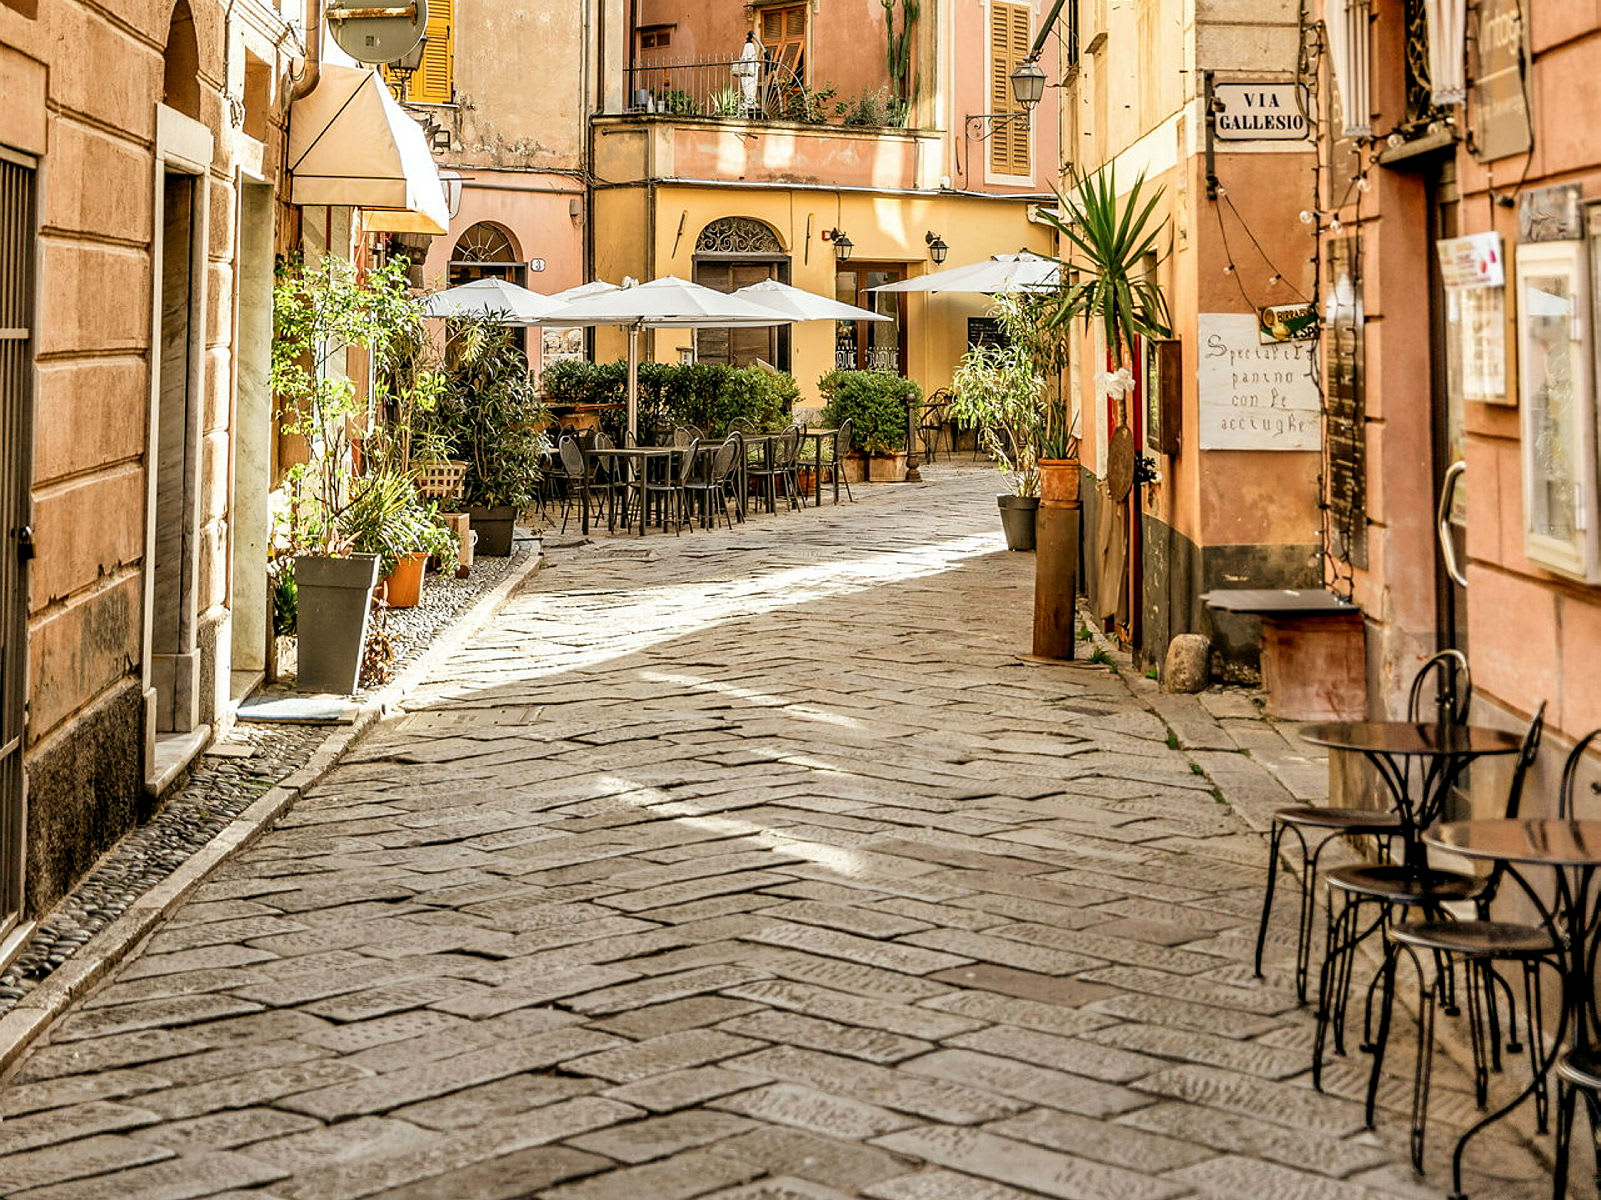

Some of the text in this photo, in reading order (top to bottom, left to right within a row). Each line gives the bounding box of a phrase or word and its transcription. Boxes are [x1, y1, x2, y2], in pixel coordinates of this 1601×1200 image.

[1243, 92, 1280, 108] VIA
[1219, 115, 1304, 130] GALLESIO
[1232, 371, 1293, 389] panino
[1231, 394, 1259, 407] con
[1221, 412, 1305, 438] acciughe
